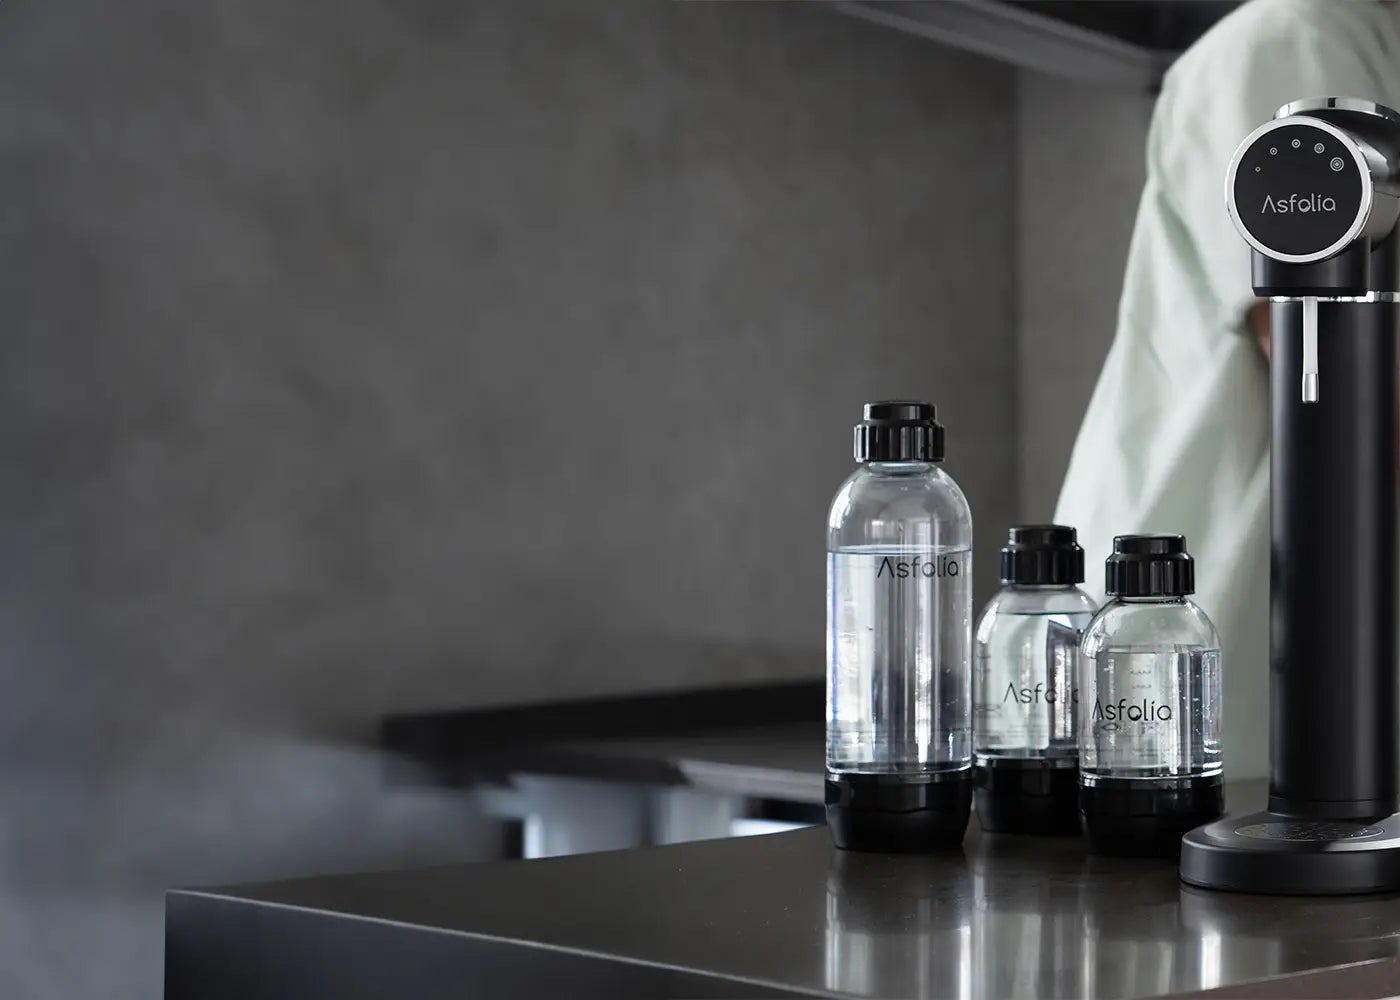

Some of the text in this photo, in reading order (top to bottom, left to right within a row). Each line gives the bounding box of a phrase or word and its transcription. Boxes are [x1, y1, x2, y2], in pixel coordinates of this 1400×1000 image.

[1261, 193, 1337, 214] Asfolia
[877, 555, 959, 578] Asfolia
[1003, 682, 1079, 704] Asfo
[1092, 698, 1172, 721] Asfolia
